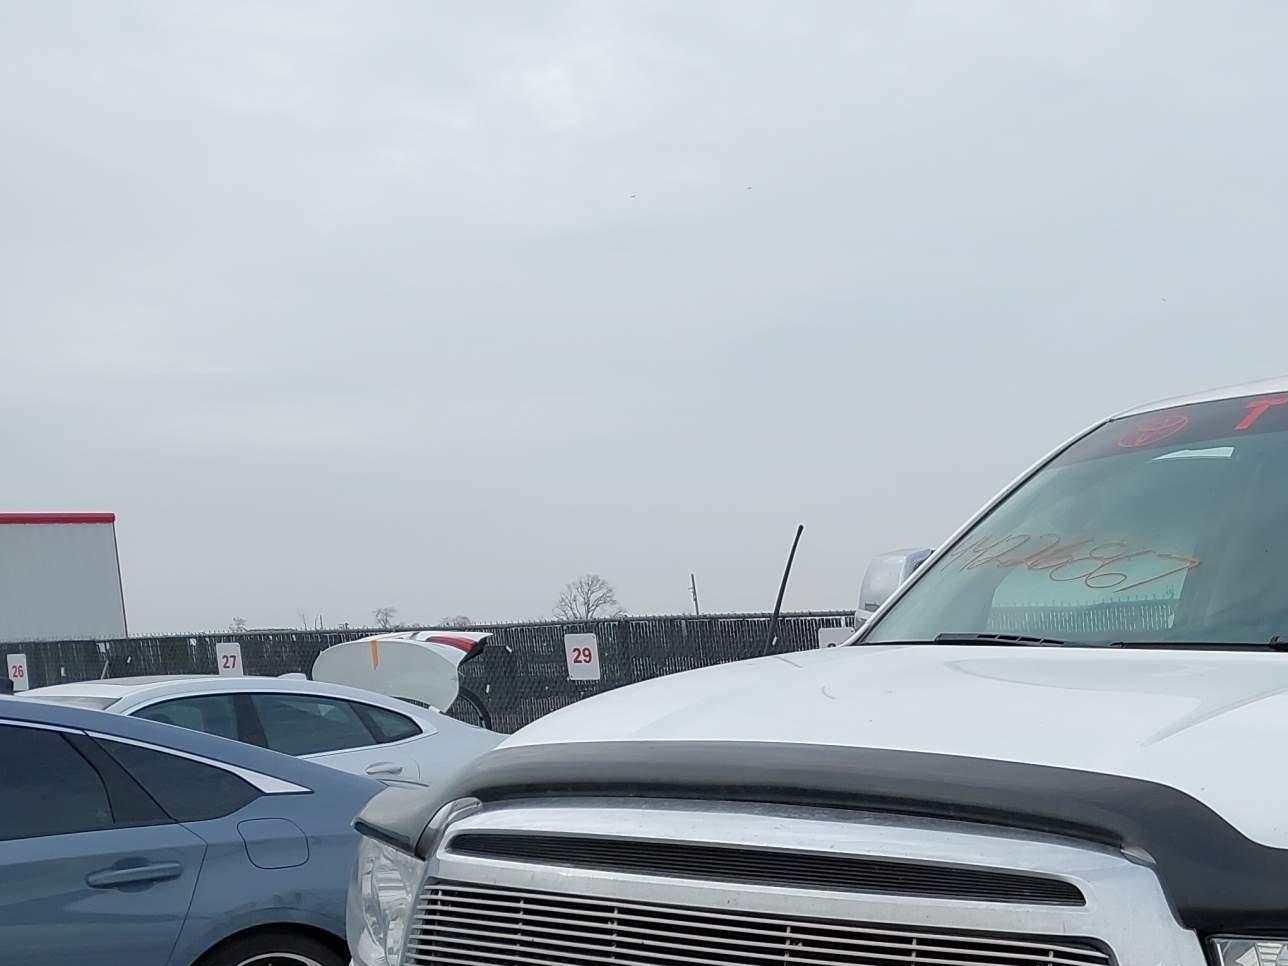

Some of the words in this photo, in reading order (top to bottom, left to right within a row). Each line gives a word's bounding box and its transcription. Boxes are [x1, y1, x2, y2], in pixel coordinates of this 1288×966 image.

[222, 655, 236, 669] 27
[573, 647, 592, 665] 29
[11, 665, 24, 679] 26
